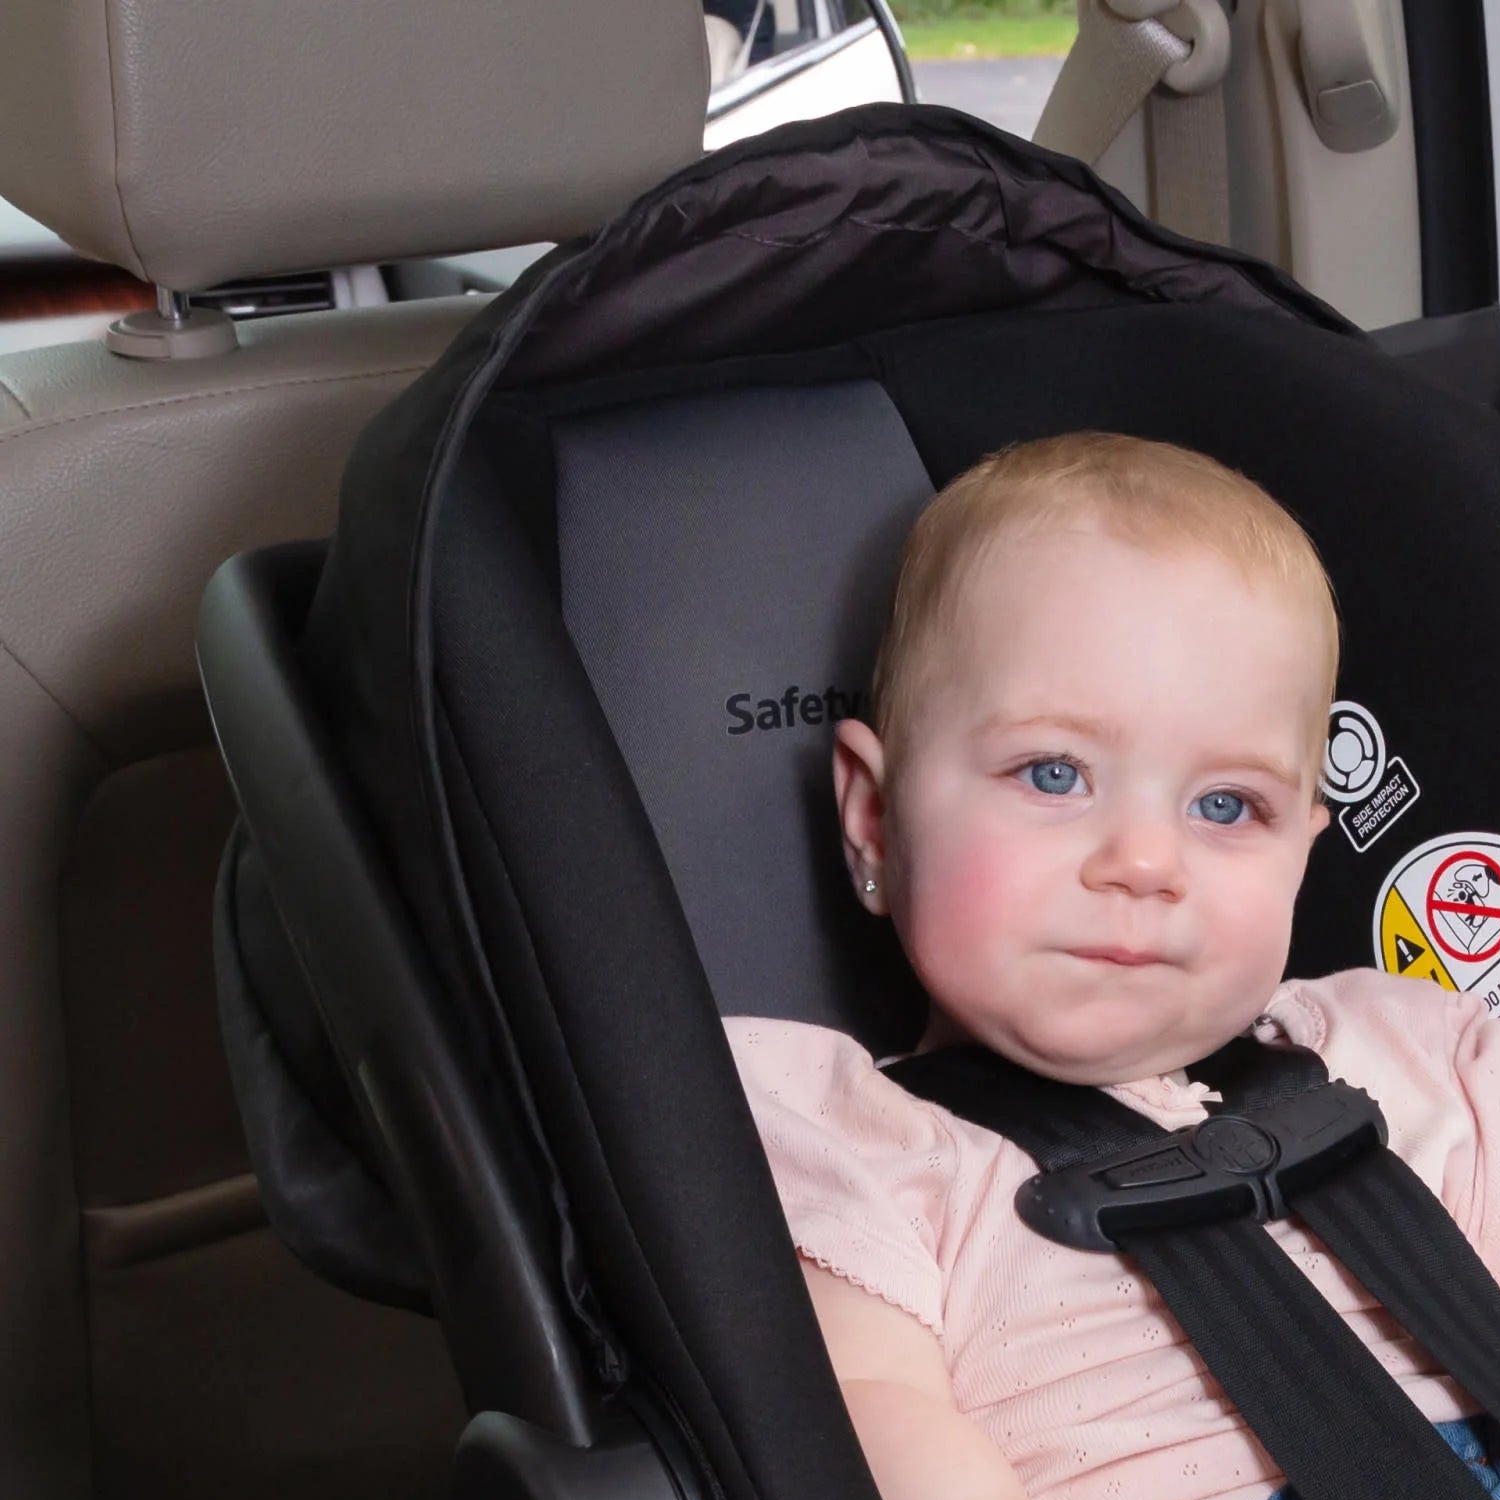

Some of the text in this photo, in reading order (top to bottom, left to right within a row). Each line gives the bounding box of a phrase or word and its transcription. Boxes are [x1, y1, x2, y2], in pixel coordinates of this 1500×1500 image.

[726, 685, 862, 736] Safety
[1352, 774, 1402, 827] SIDE IMPACT
[1358, 784, 1409, 838] PROTECTION
